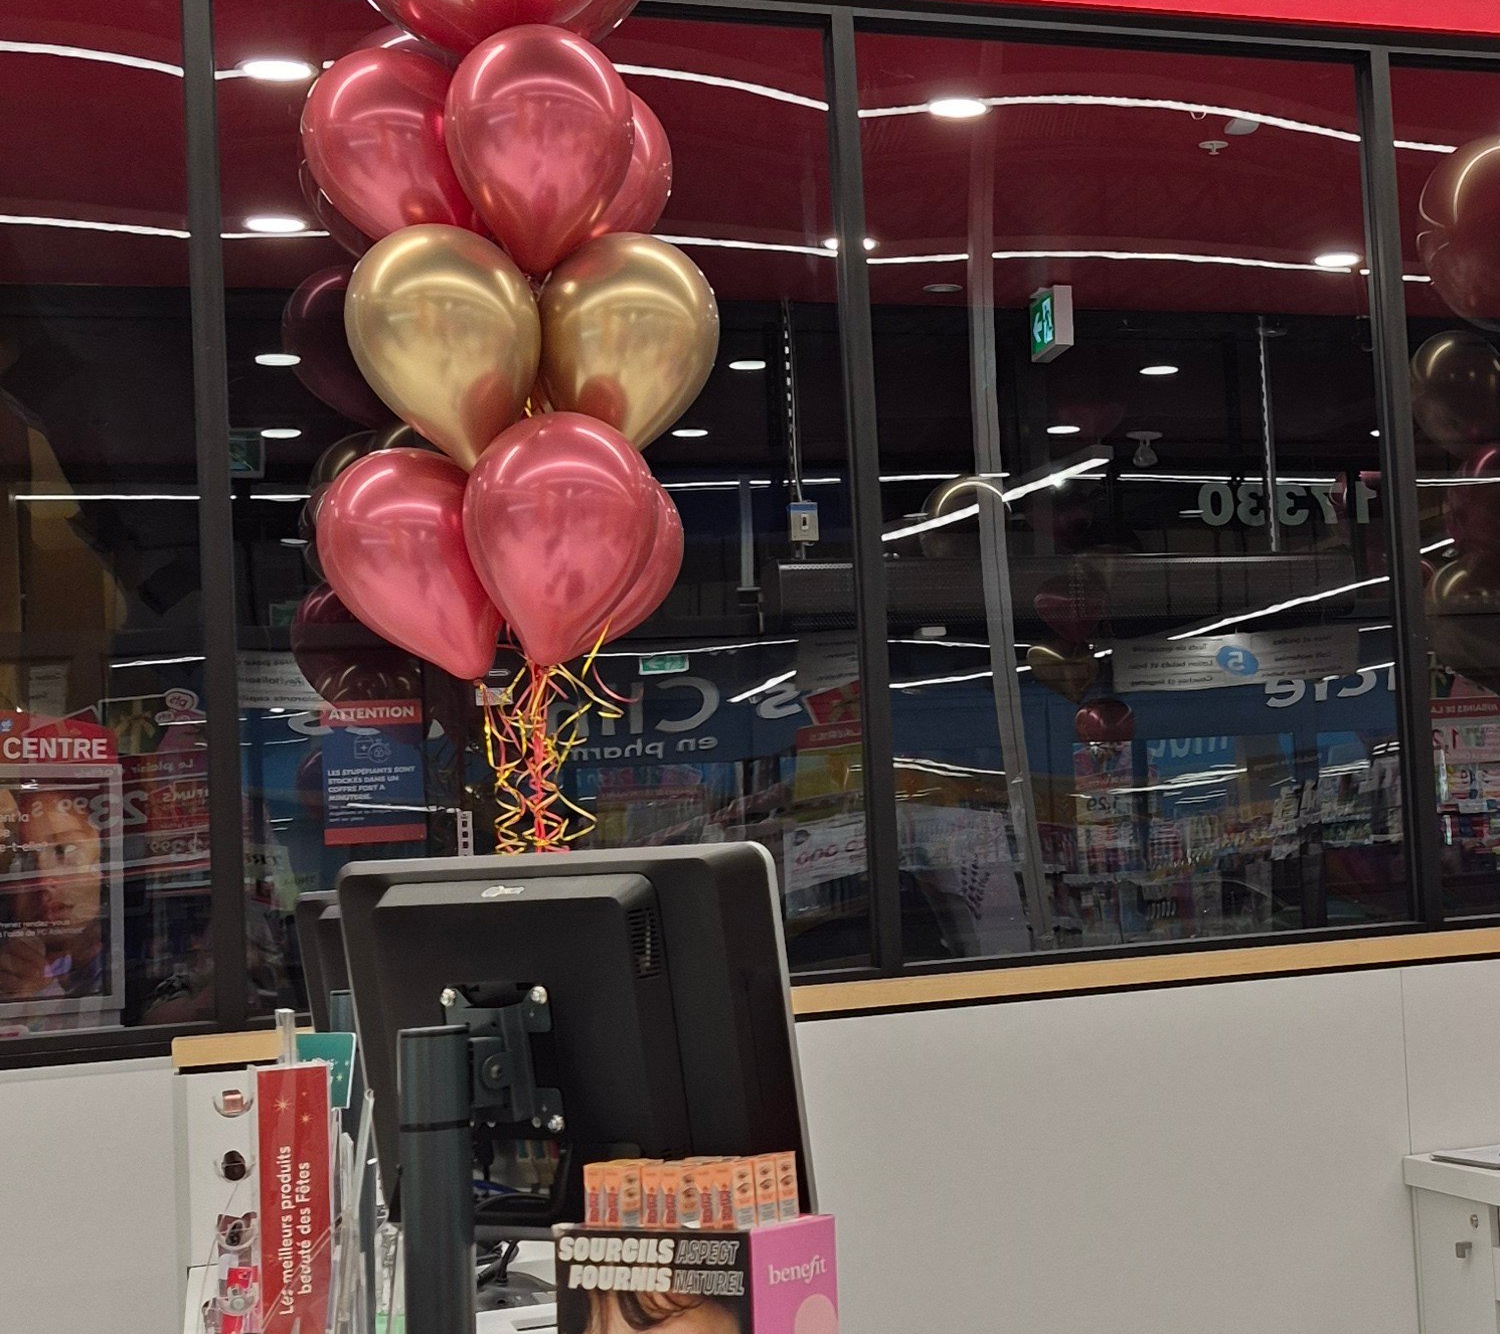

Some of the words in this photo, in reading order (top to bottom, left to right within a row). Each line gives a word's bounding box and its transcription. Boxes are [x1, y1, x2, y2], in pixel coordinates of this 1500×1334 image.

[329, 706, 415, 721] ATTENTION
[3, 736, 109, 760] CENTRE
[276, 1146, 296, 1210] produits
[295, 1162, 311, 1203] Fêtes
[297, 1207, 311, 1235] des
[278, 1215, 293, 1284] meilleurs
[558, 1236, 675, 1264] SOURCILS
[675, 1239, 740, 1265] ASPECT
[297, 1240, 312, 1295] beauté
[568, 1265, 673, 1292] FOURNIS
[672, 1269, 745, 1296] NATUREL
[768, 1255, 827, 1285] benefit
[279, 1288, 294, 1315] Les
